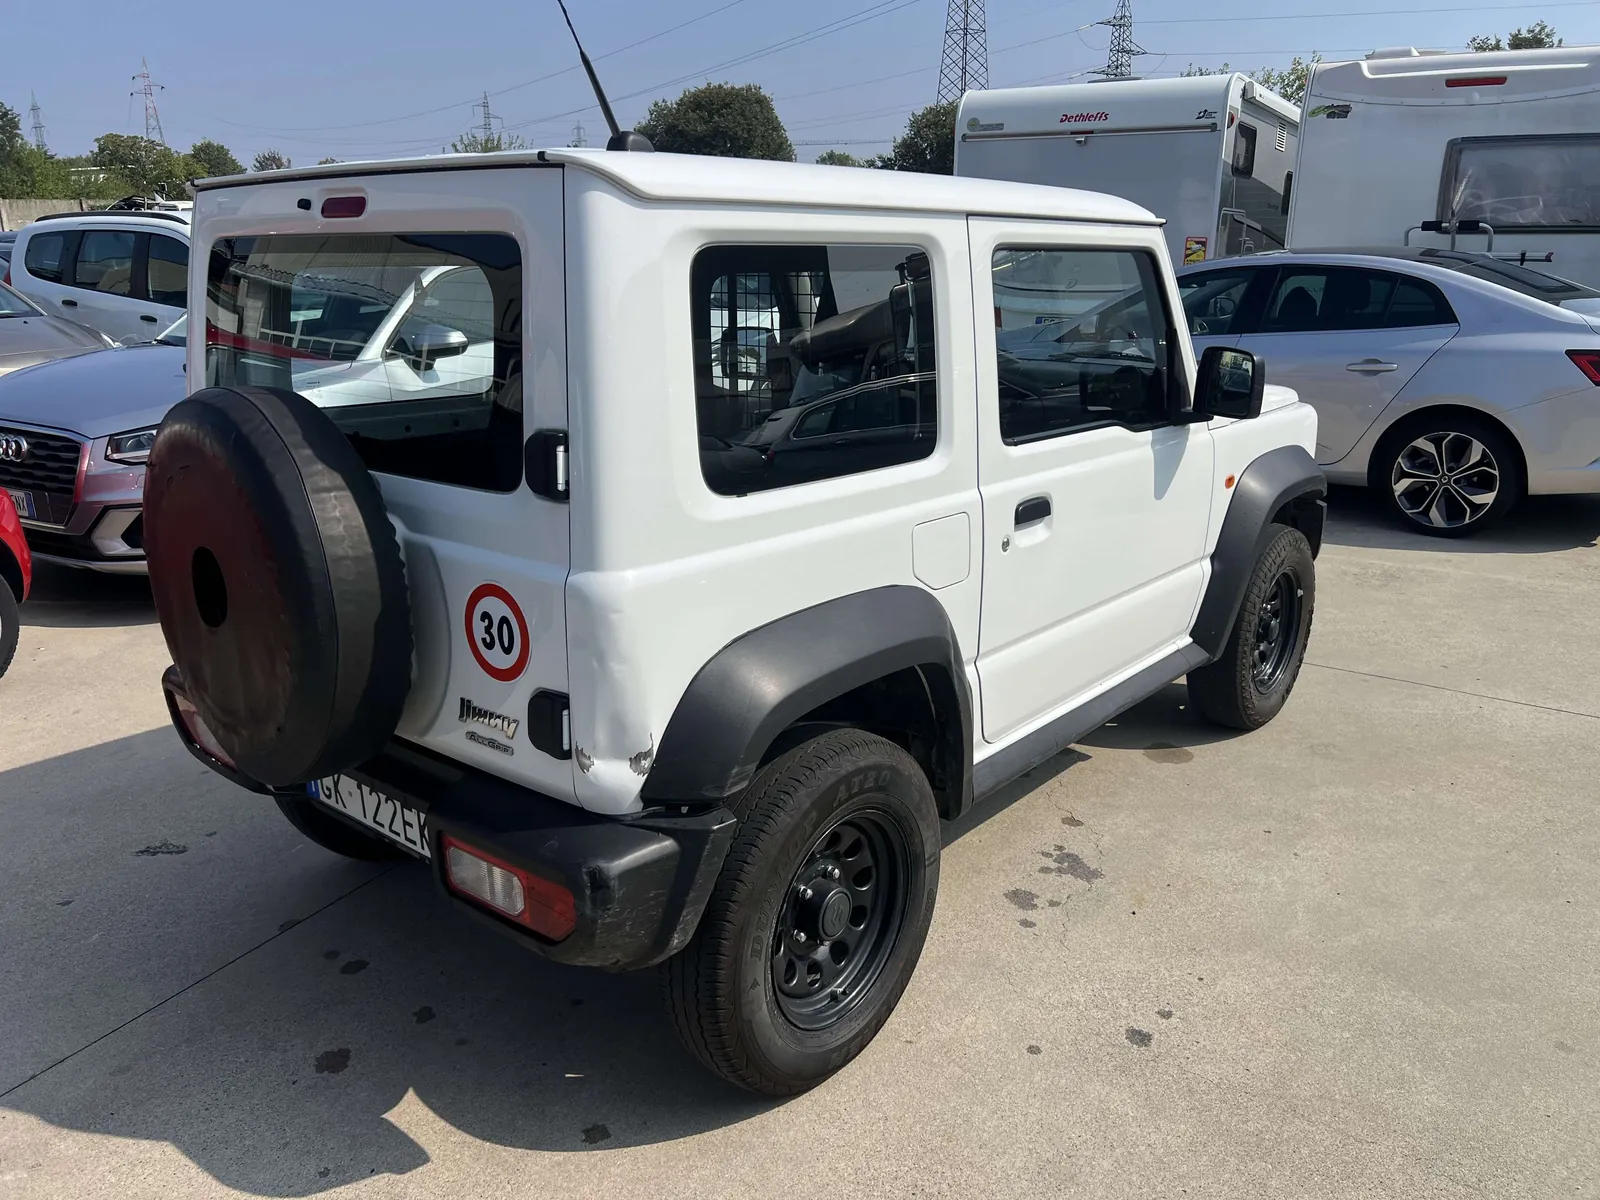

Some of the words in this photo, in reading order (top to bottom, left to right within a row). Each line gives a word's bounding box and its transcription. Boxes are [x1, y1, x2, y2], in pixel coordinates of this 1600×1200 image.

[1059, 111, 1109, 123] Dethleffs
[480, 611, 514, 656] 30
[749, 811, 817, 961] DUNLOP
